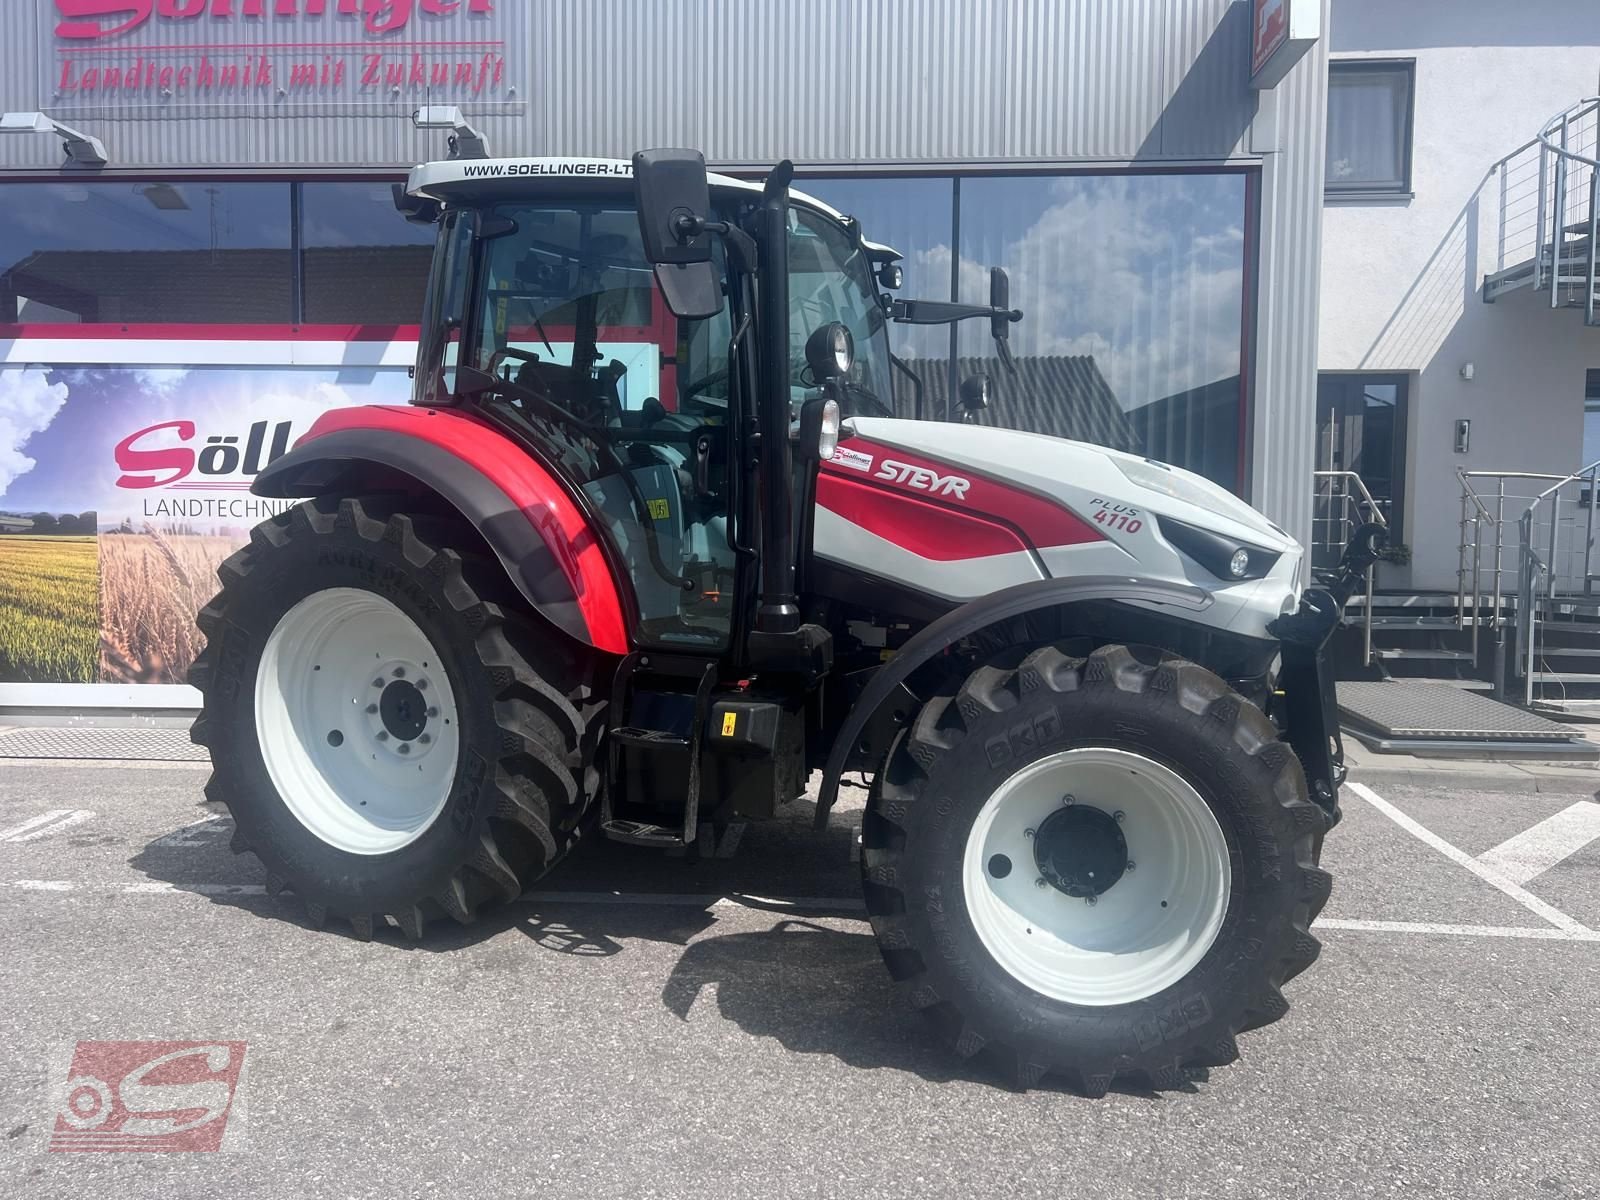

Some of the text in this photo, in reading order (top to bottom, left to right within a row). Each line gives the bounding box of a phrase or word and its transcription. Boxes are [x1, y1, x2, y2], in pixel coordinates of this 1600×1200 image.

[58, 52, 504, 93] Landtechnik mit Zukunft
[874, 459, 971, 501] STEYR
[1089, 498, 1141, 517] PLUS
[1093, 509, 1143, 534] 4110
